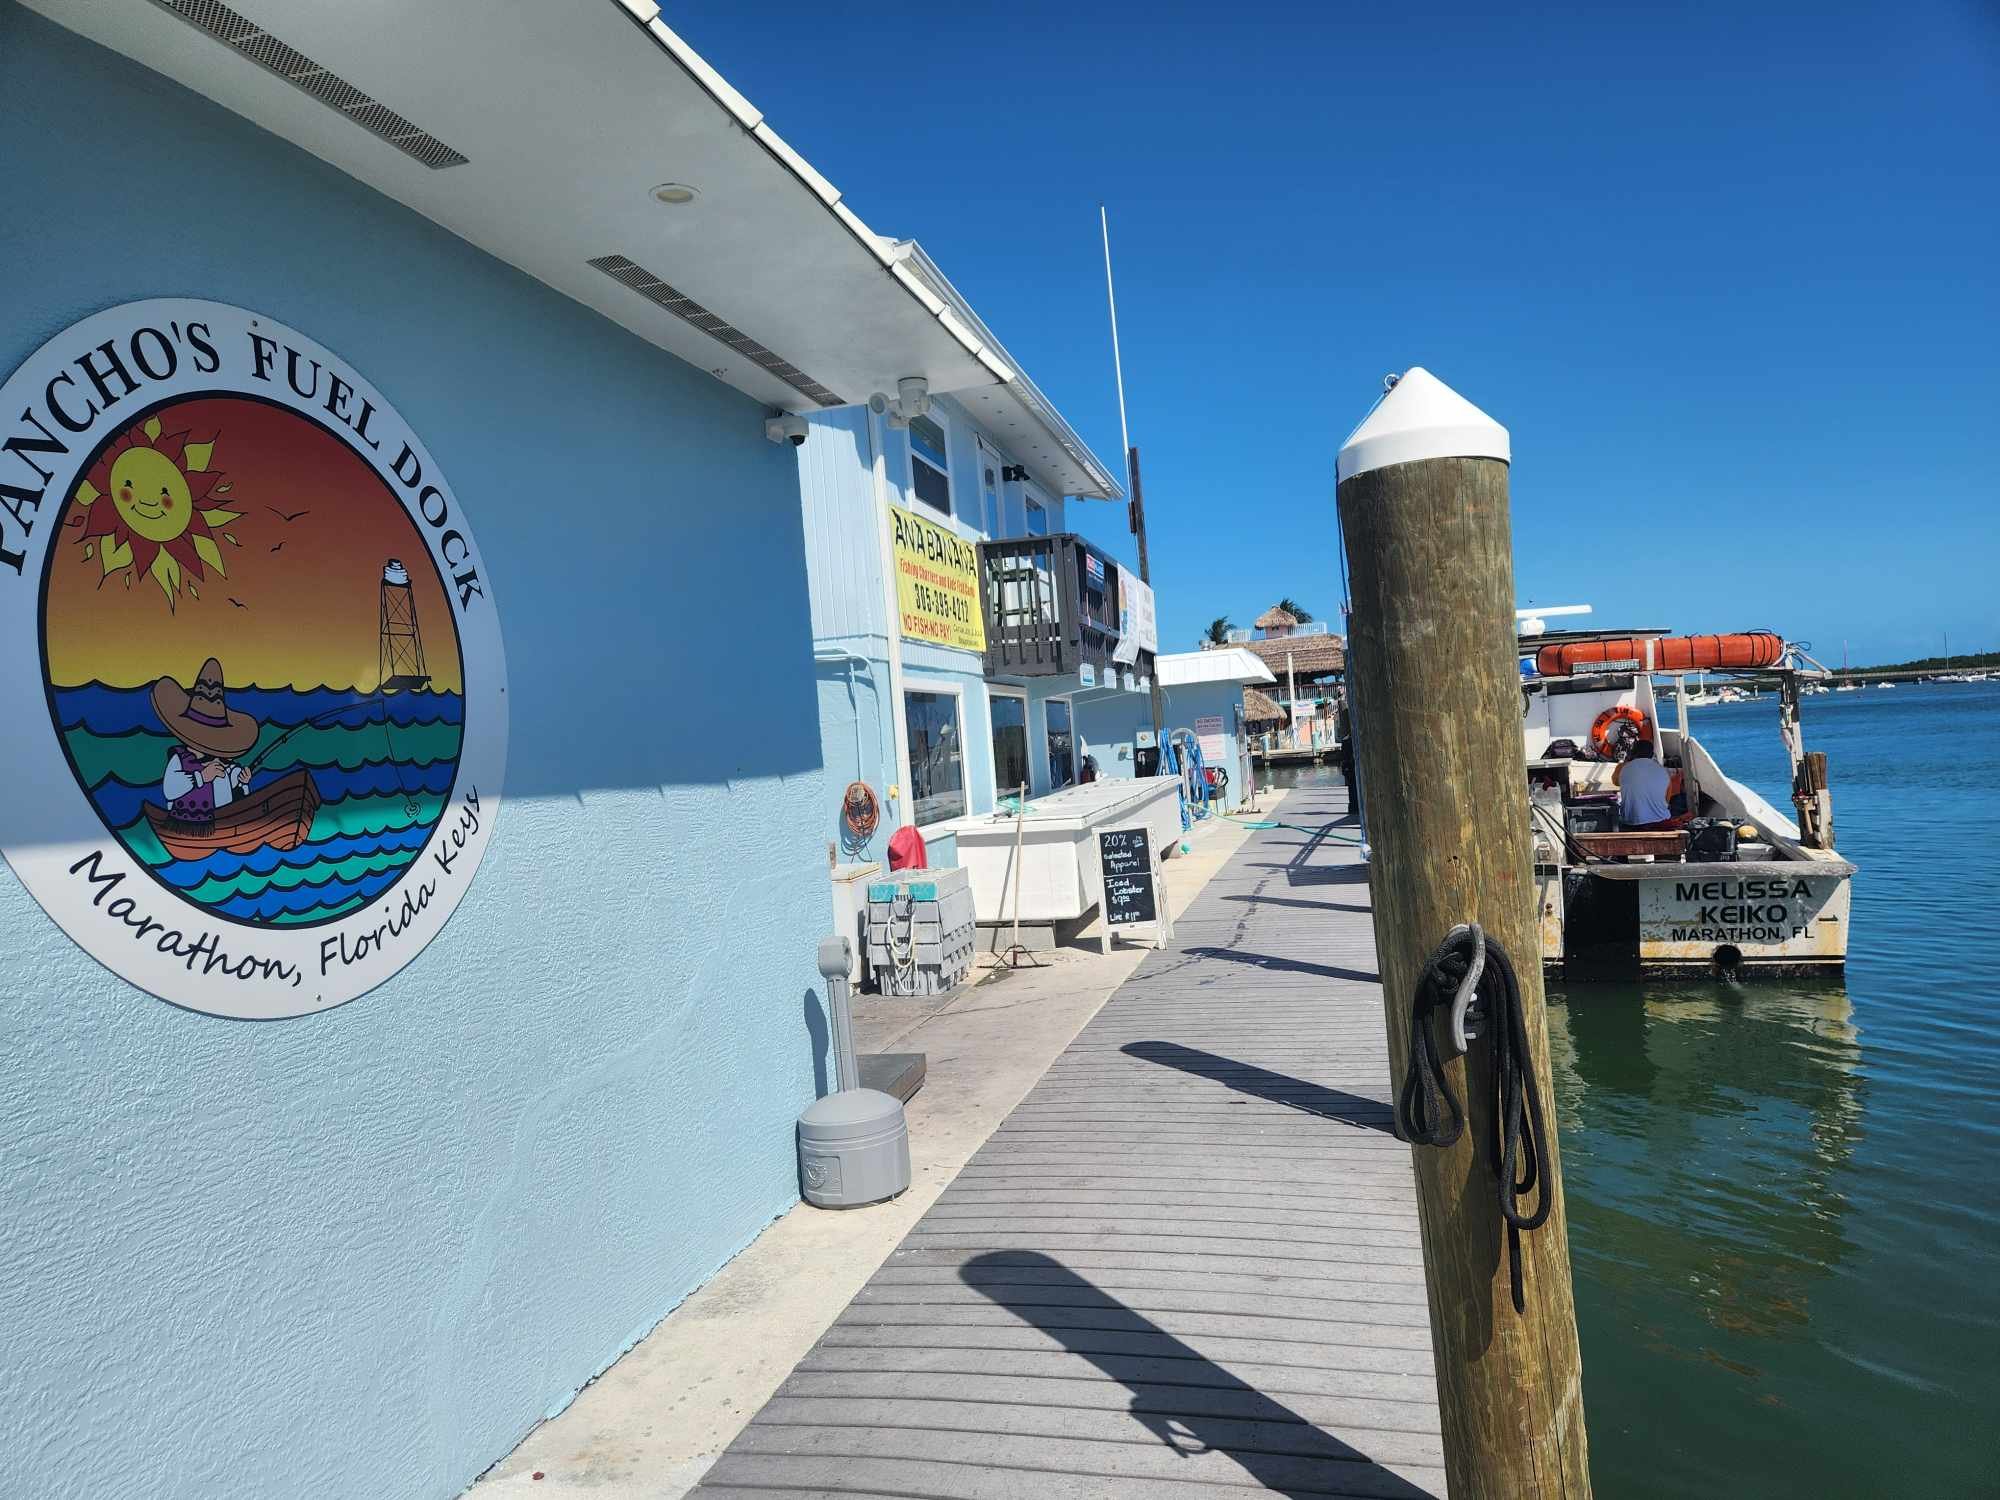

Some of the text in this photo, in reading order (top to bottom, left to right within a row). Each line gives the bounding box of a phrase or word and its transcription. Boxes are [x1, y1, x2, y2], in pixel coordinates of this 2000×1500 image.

[246, 331, 382, 451] FUEL
[388, 440, 485, 613] DOCK
[891, 508, 977, 578] ANA BANANA
[914, 582, 969, 623] 305-395-4212
[1104, 834, 1128, 848] 20%
[68, 785, 481, 987] Marathon, Florida Keys
[1106, 877, 1130, 888] Iced
[1113, 885, 1145, 896] Lobster
[1676, 879, 1812, 902] MELISSA
[1701, 904, 1788, 924] KEIKO
[1672, 926, 1815, 942] MARATHON, FL
